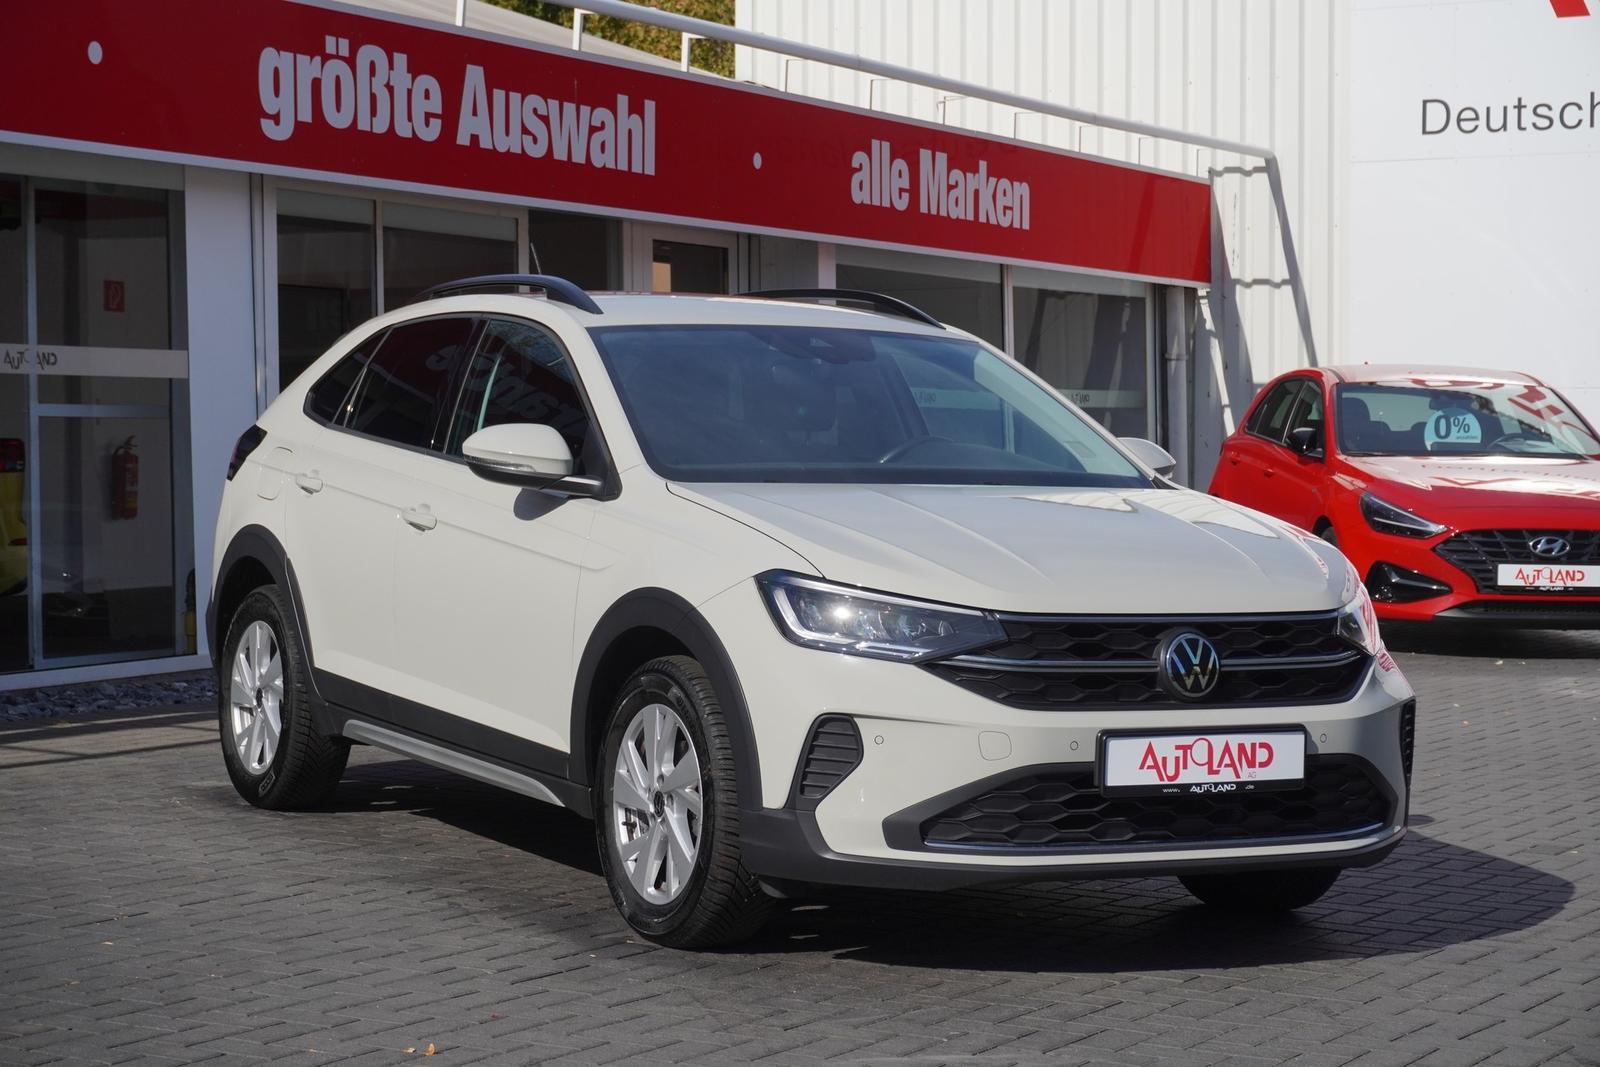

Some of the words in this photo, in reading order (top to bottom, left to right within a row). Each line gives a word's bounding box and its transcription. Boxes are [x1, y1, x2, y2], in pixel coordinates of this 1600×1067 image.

[258, 35, 442, 141] größte
[456, 64, 656, 176] Auswahl
[851, 139, 910, 211] alle
[919, 148, 1030, 230] Marken
[1434, 414, 1470, 440] 0%
[1515, 566, 1585, 586] AUTOLAND
[1139, 737, 1274, 782] AUTOLAND
[1247, 771, 1257, 779] AG
[1189, 783, 1237, 794] AUTOLAND
